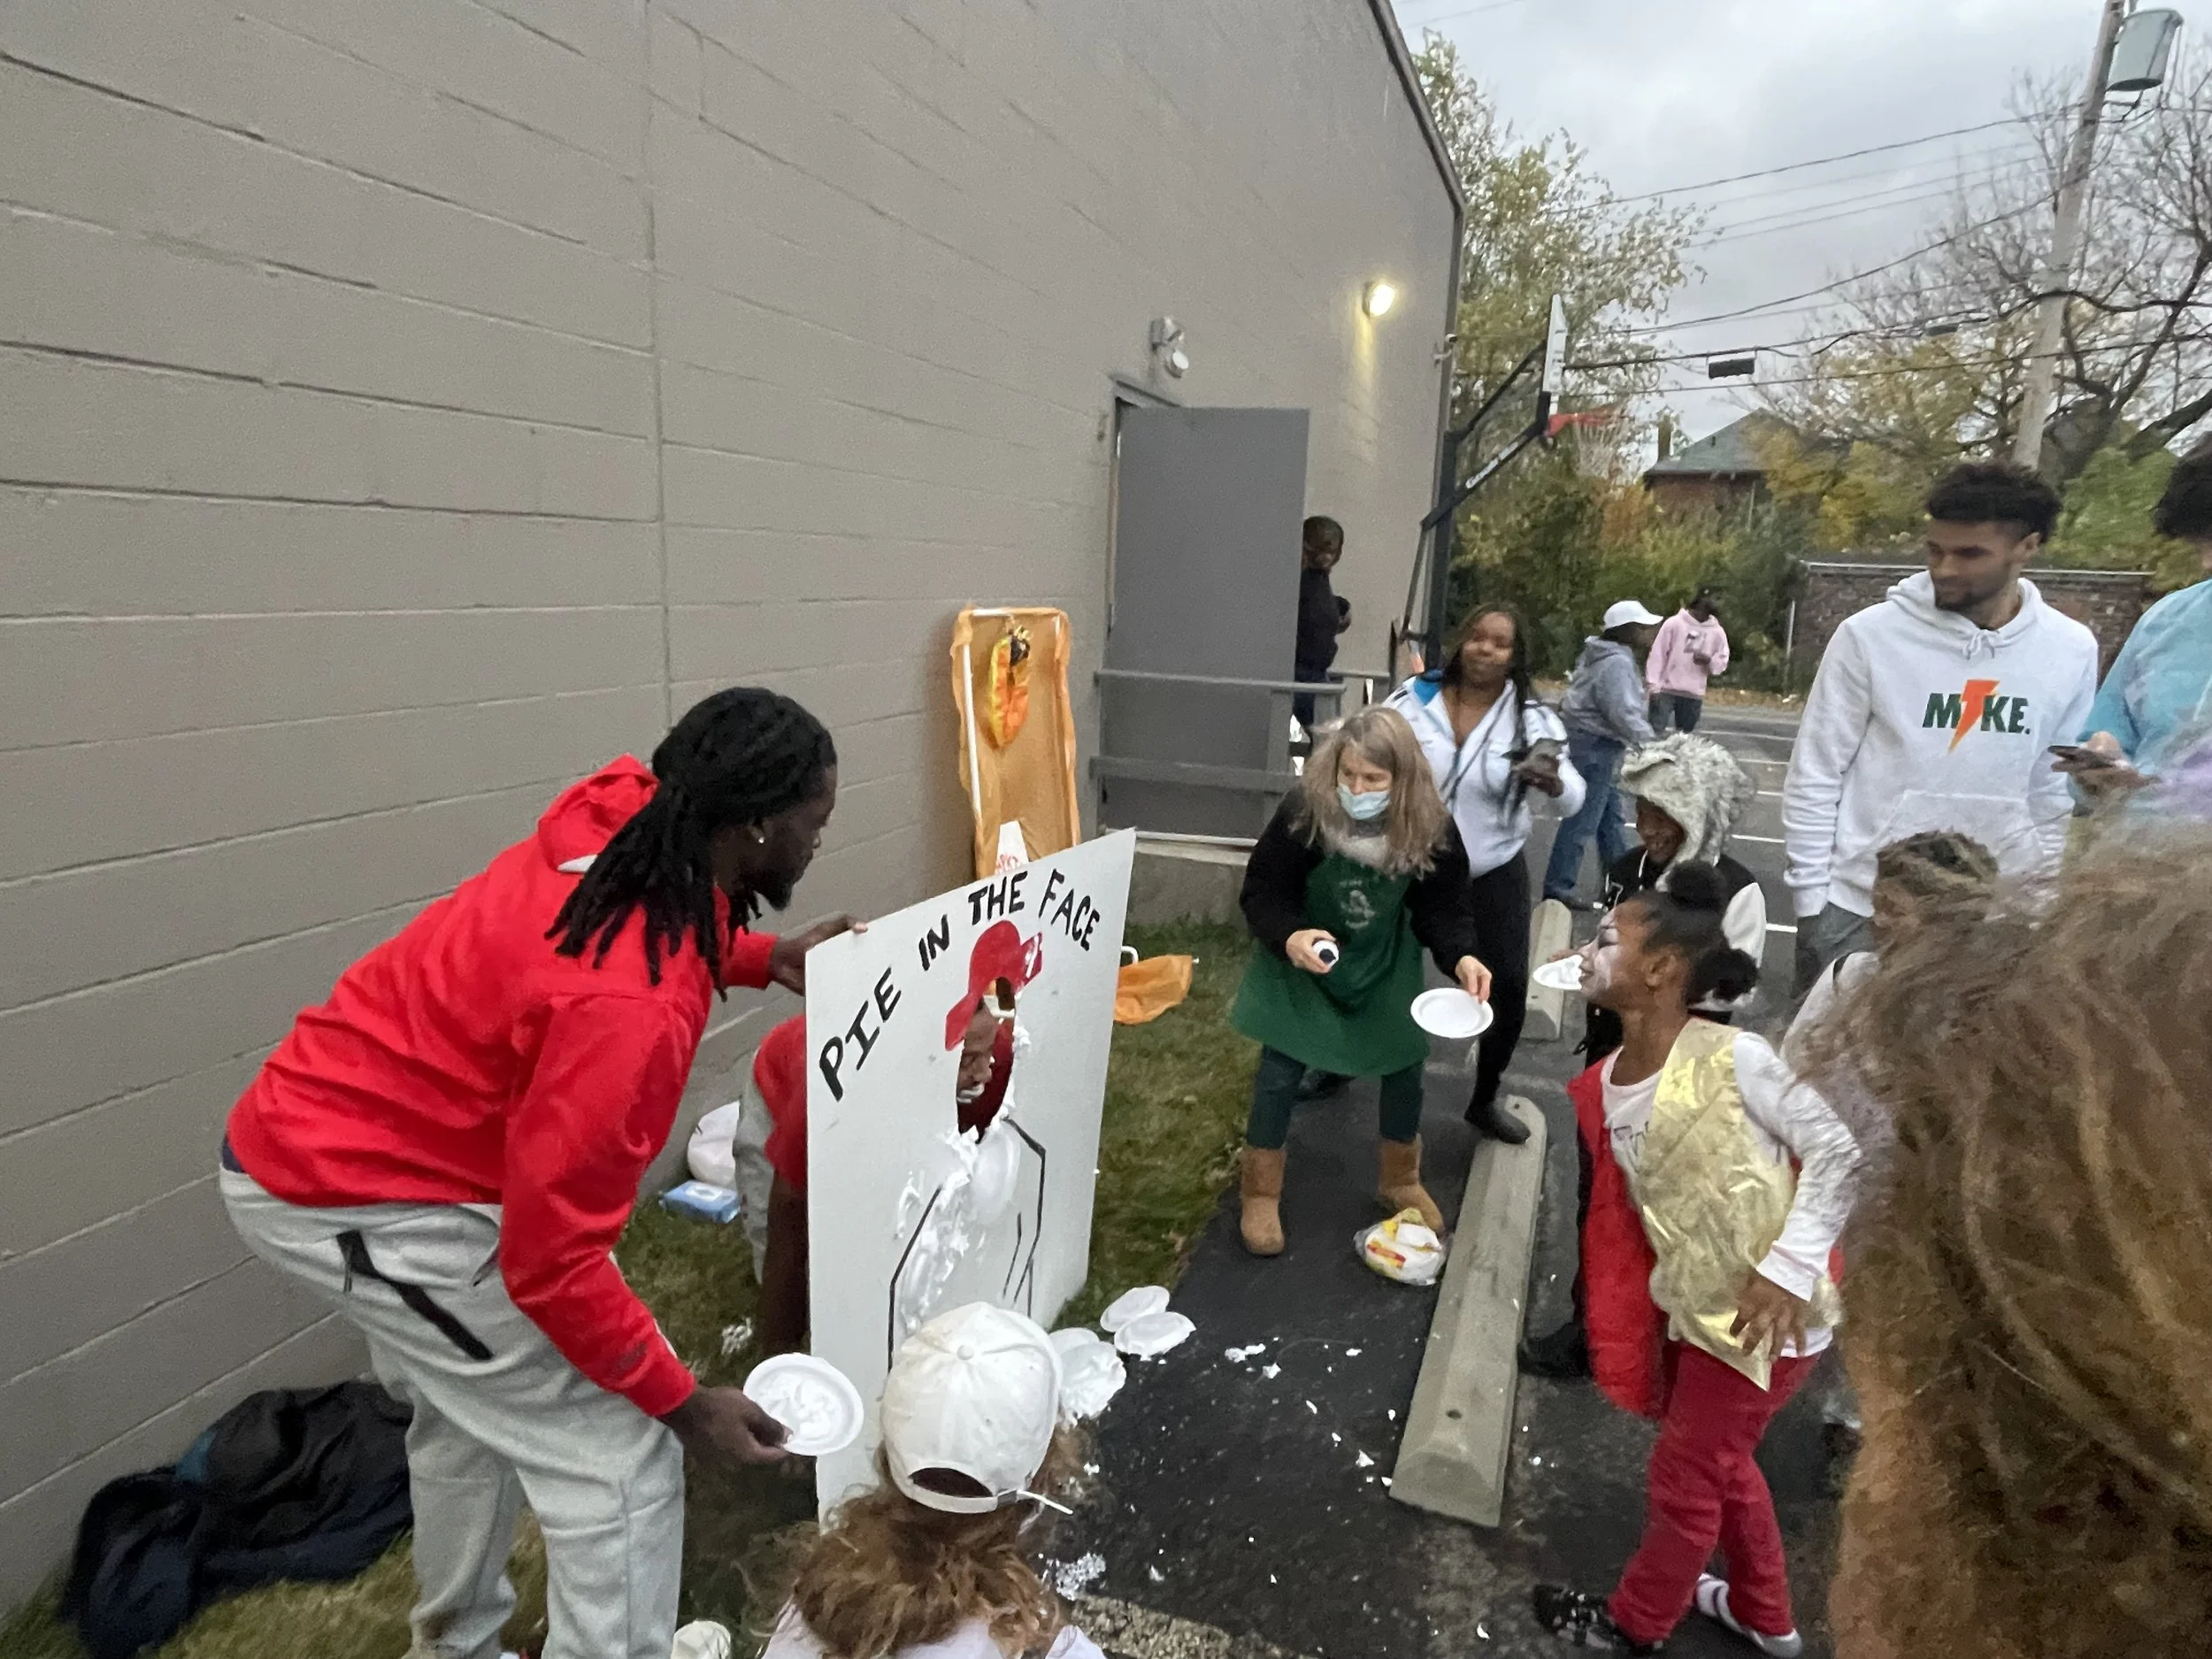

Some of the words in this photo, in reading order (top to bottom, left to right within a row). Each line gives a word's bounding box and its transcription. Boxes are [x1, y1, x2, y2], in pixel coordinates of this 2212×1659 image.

[819, 967, 902, 1102] PIE
[918, 914, 950, 971] IN
[968, 871, 1028, 925] THE
[1038, 869, 1100, 951] FACE
